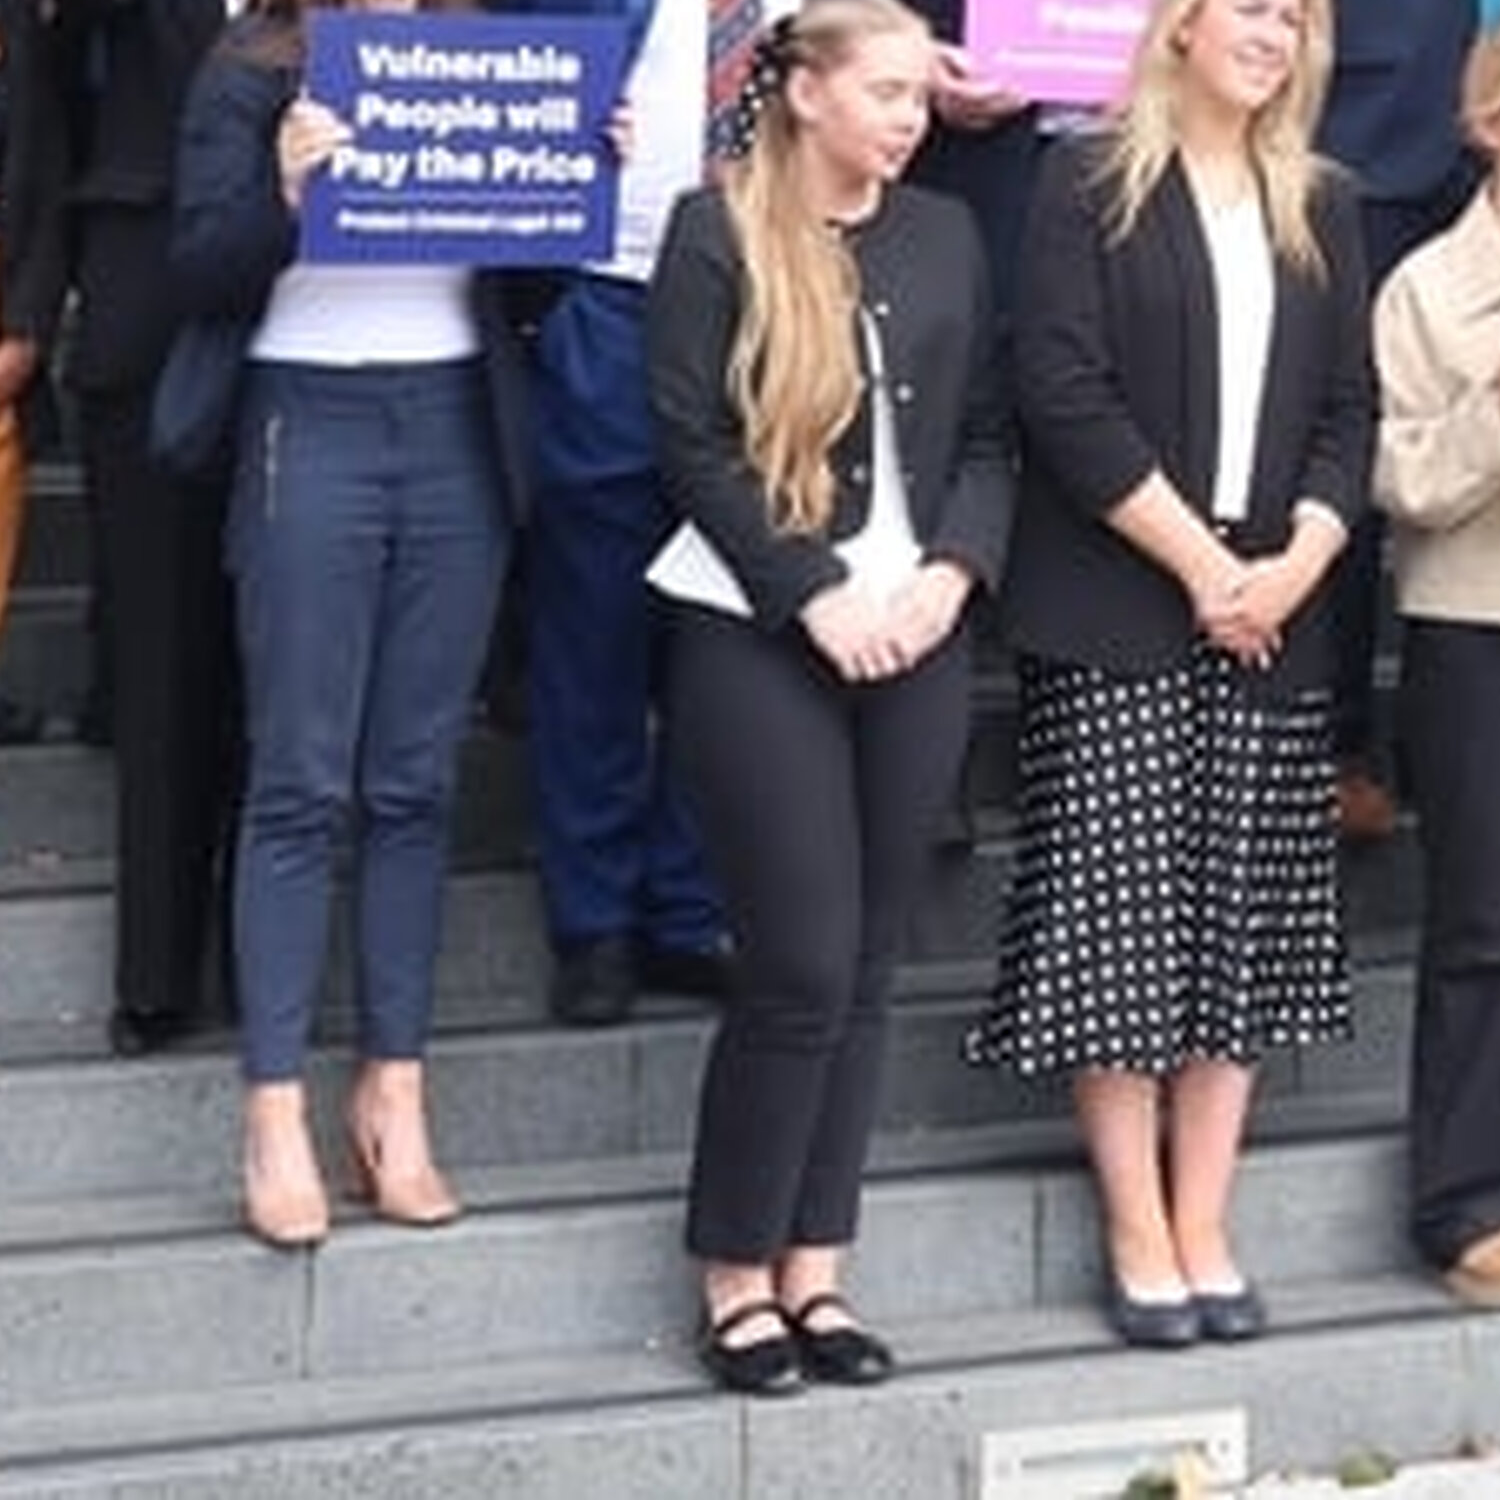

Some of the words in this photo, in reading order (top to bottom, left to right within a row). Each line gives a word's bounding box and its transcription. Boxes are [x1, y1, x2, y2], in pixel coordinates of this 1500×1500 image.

[357, 43, 583, 83] Vulnerable
[356, 92, 500, 138] People
[506, 96, 579, 132] will
[331, 146, 409, 188] Pay
[416, 146, 486, 182] the
[492, 147, 596, 184] Price
